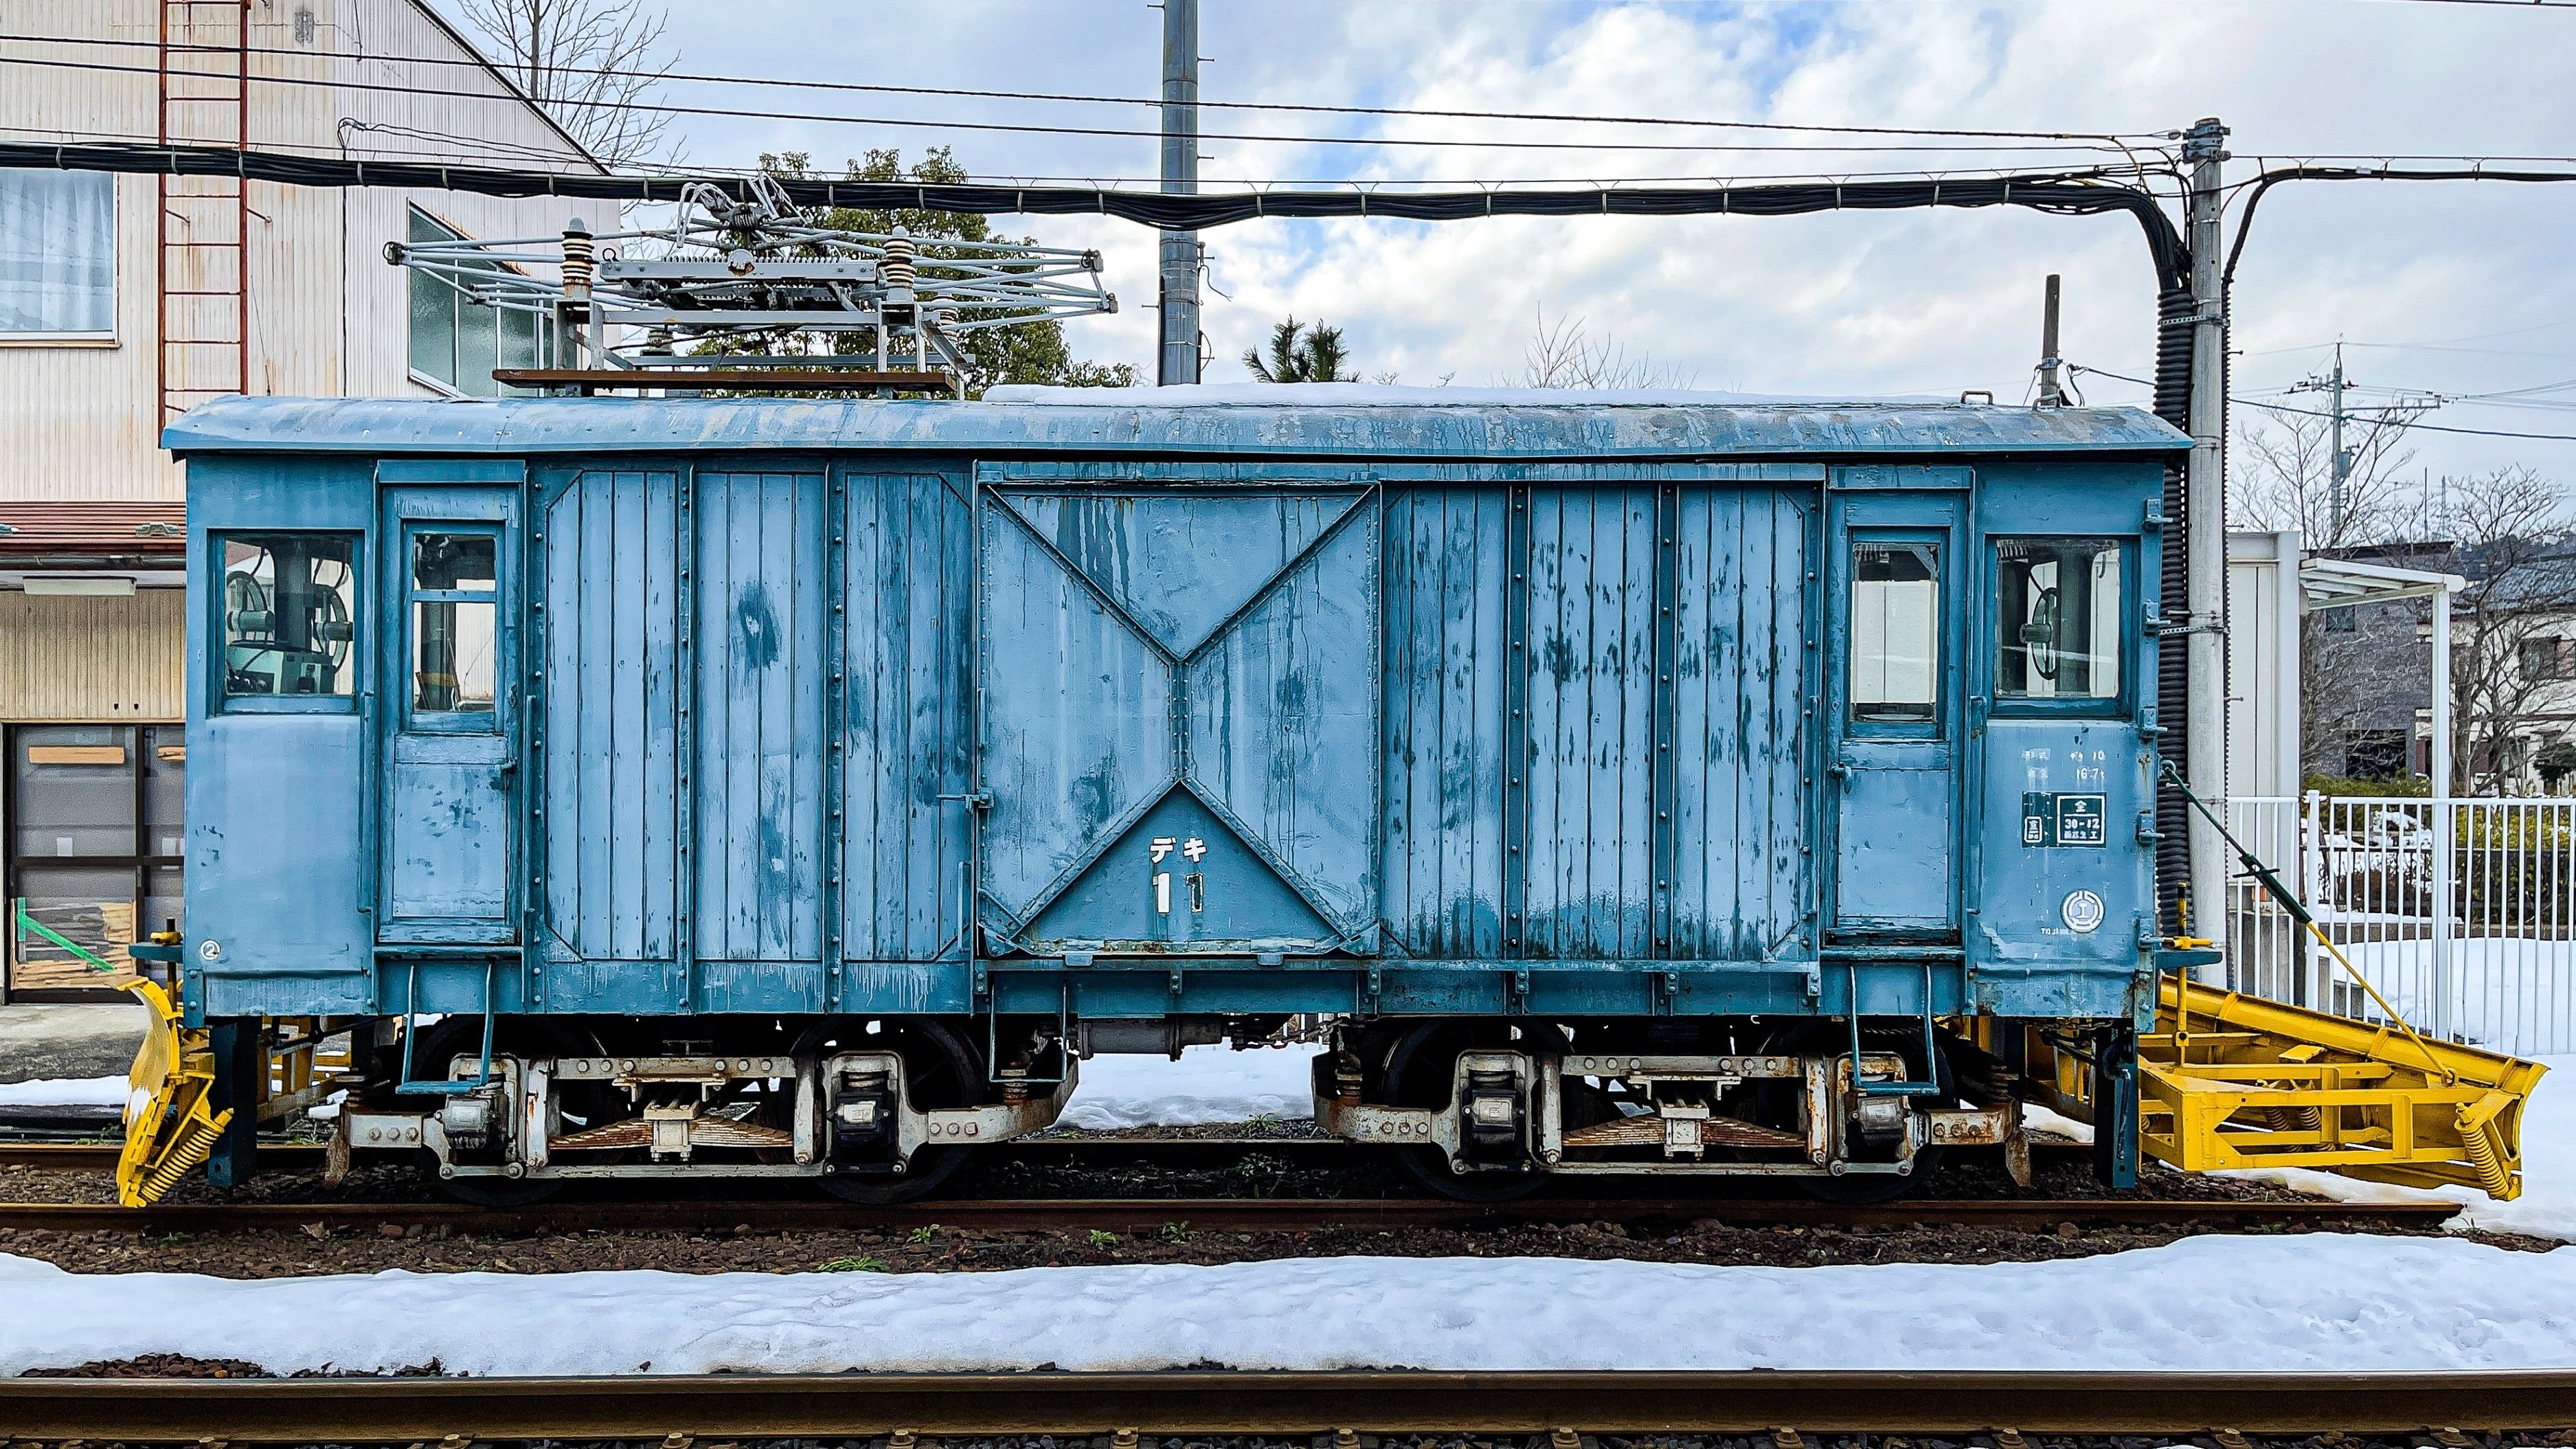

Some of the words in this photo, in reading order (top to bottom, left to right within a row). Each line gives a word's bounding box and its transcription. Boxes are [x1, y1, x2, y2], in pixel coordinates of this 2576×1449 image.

[2075, 800, 2087, 812] 全
[2064, 818, 2100, 829] 30-12
[1149, 837, 1207, 864] デキ
[1152, 872, 1204, 913] 11
